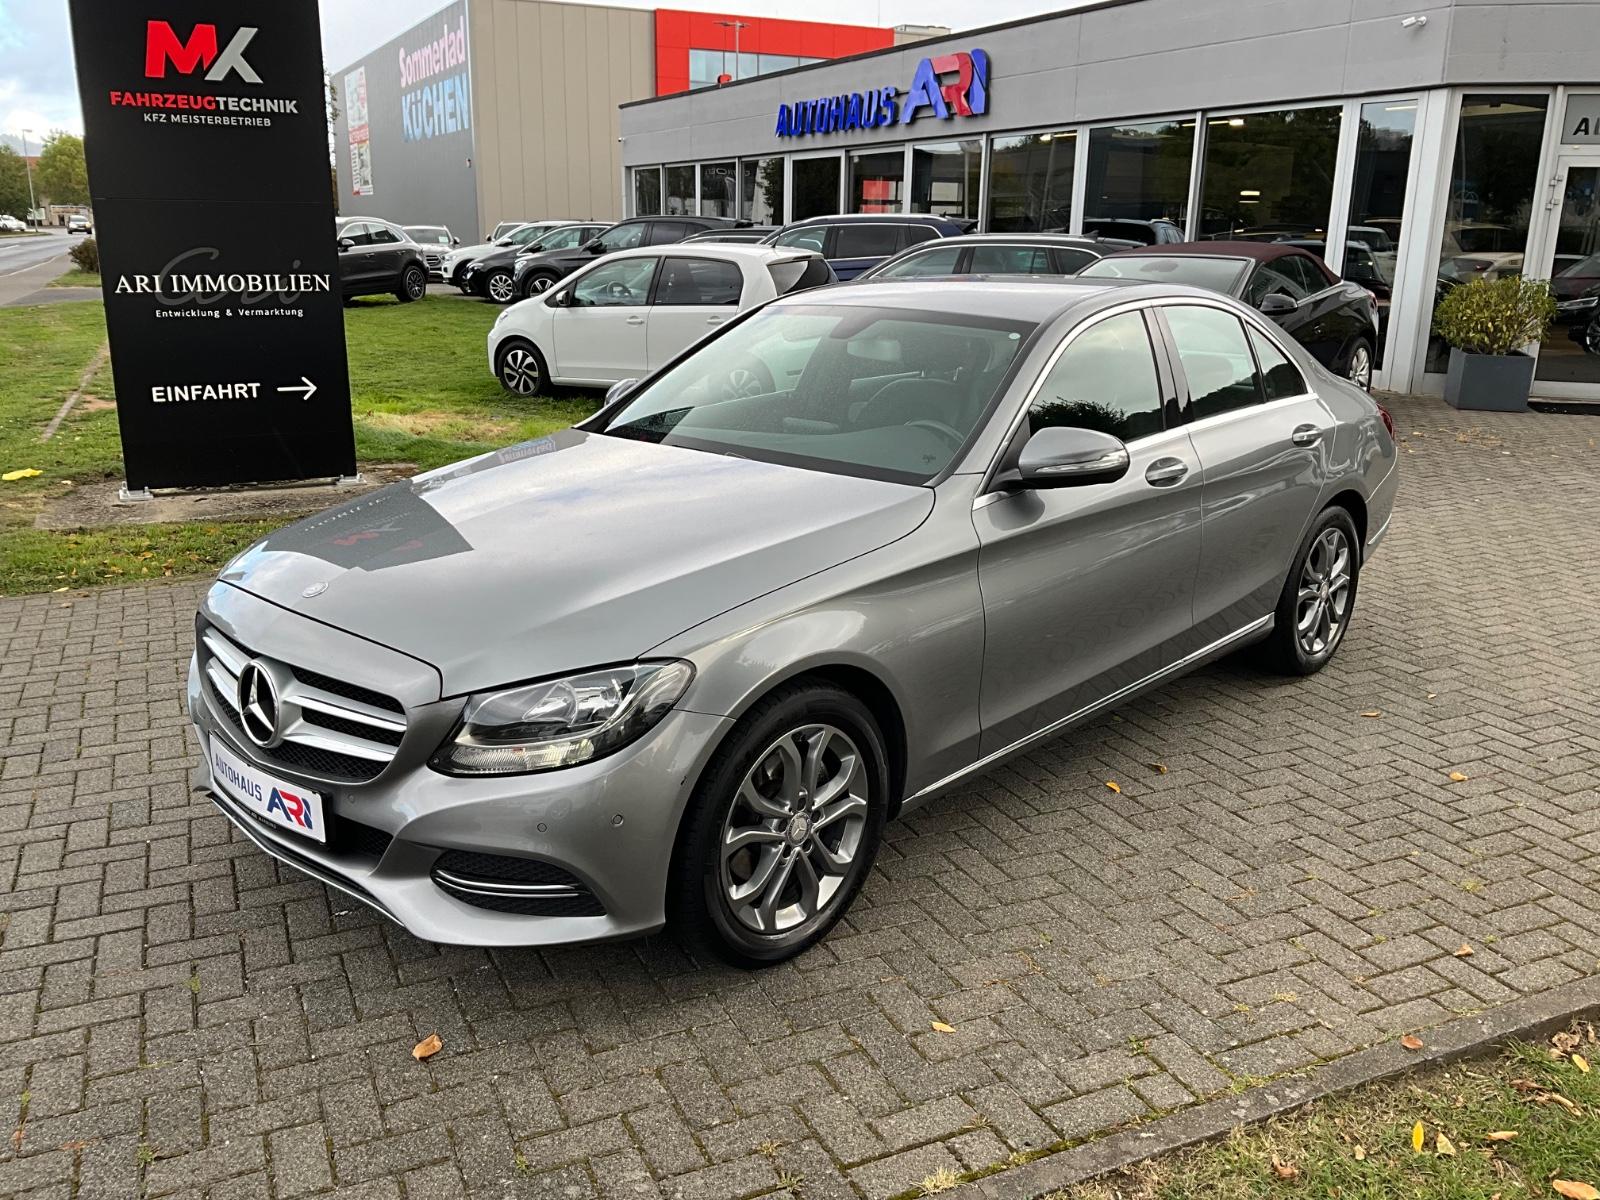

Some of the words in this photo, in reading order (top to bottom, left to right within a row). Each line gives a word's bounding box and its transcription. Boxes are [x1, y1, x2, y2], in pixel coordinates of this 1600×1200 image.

[145, 20, 263, 84] MK
[400, 16, 466, 88] Sommerlad
[110, 91, 299, 113] FAHRZEUGTECHNIK
[402, 72, 469, 143] KÜCHEN
[775, 86, 898, 138] AUTOHAUS
[901, 48, 989, 124] ARI
[143, 113, 167, 123] KFZ
[170, 114, 271, 127] MEISTERBETRIEB
[115, 274, 162, 293] ARI
[170, 273, 330, 292] IMMOBILIEN
[155, 309, 220, 318] Entwicklung
[238, 308, 304, 317] Vermarktung
[152, 382, 260, 402] EINFAHRT
[215, 754, 262, 801] AUTOHAUS
[267, 787, 313, 829] ARI
